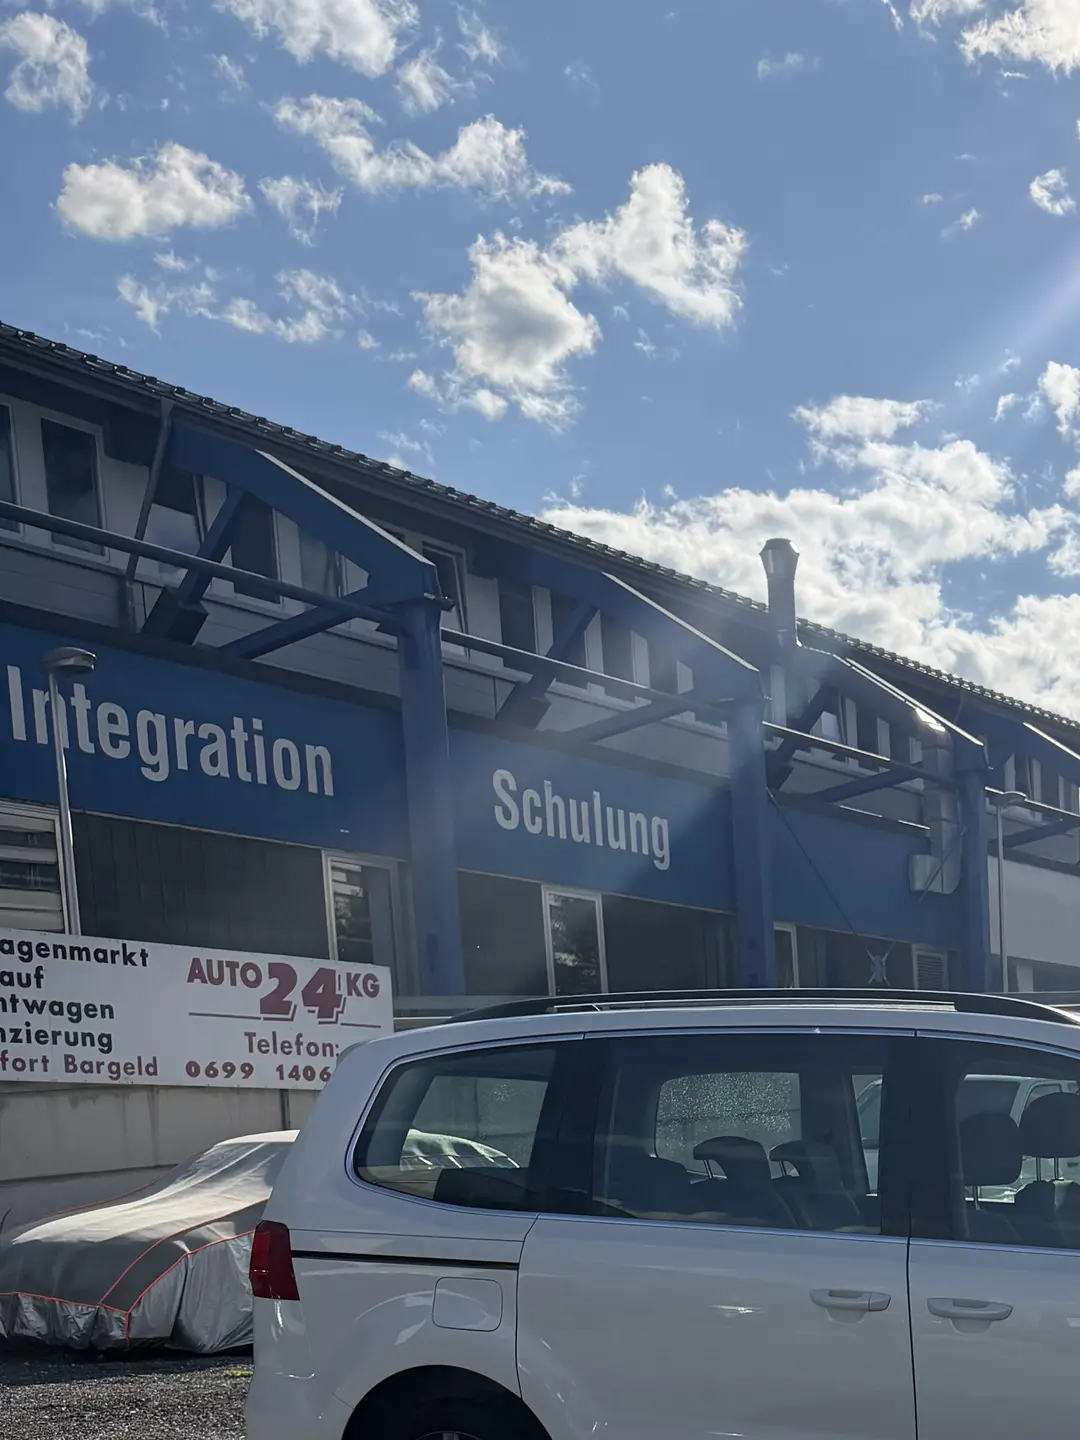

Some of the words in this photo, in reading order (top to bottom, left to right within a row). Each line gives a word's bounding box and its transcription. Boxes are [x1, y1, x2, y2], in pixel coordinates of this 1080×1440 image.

[7, 665, 334, 796] Integration
[493, 769, 671, 870] Schulung
[0, 938, 148, 967] agenmarkt
[0, 965, 44, 988] auf
[187, 957, 263, 989] AUTO
[260, 962, 346, 1025] 24
[346, 972, 380, 998] KG
[0, 1050, 49, 1072] fort
[64, 1054, 158, 1081] Bargeld
[185, 1061, 254, 1079] 0699
[275, 1064, 332, 1082] 1406
